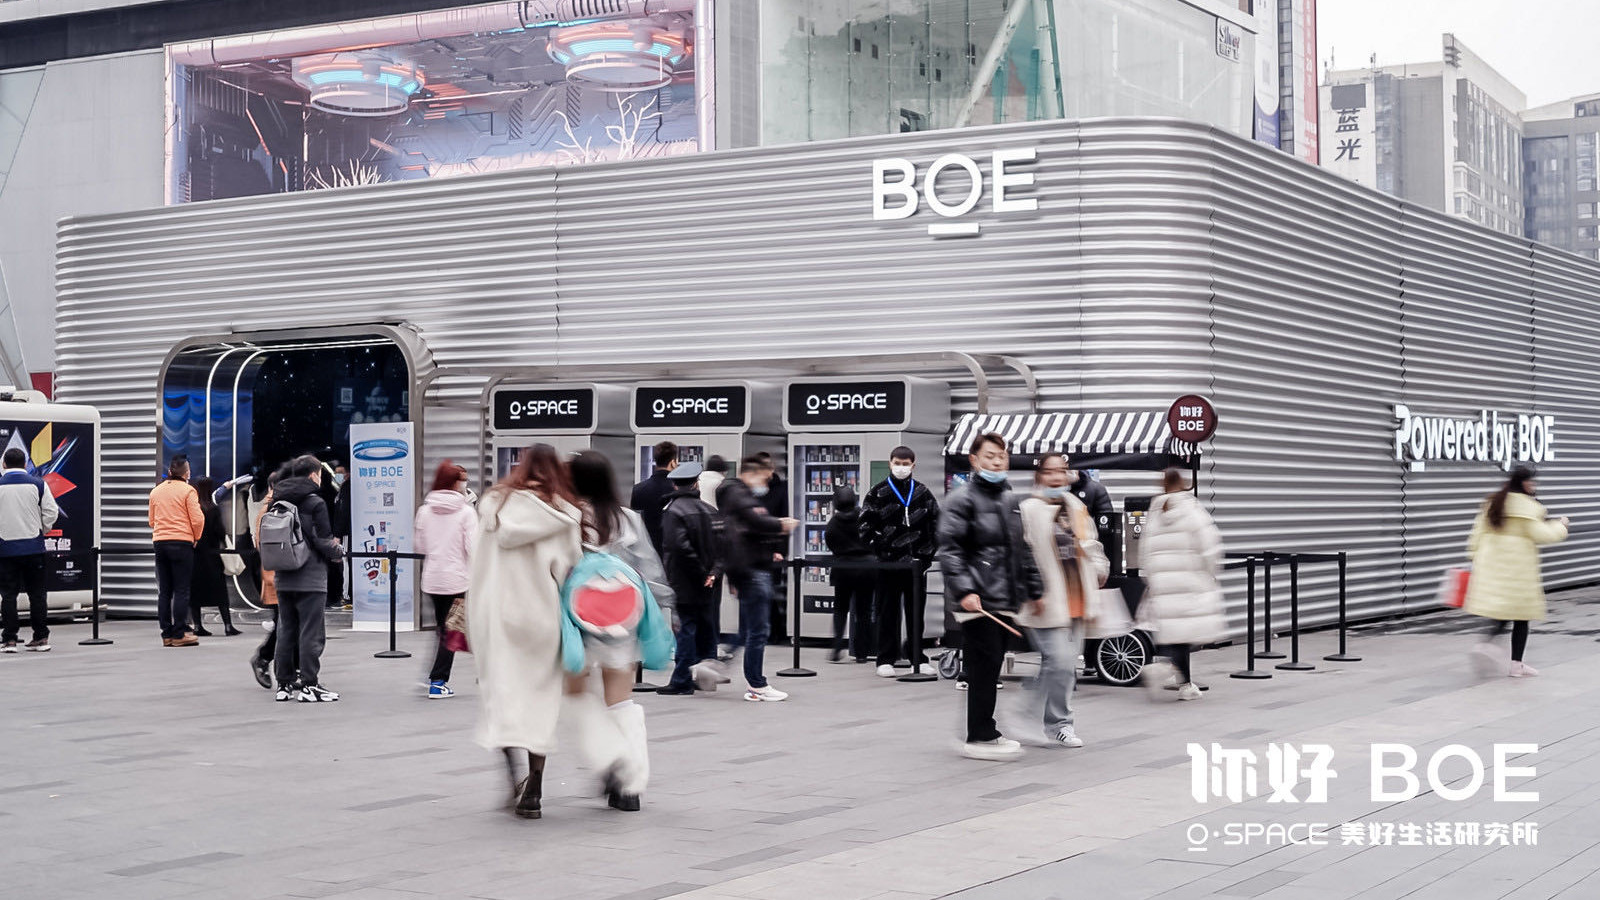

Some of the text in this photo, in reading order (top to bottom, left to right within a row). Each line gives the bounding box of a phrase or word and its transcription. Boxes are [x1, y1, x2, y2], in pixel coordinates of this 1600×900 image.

[1334, 108, 1361, 161] 蓝光
[873, 148, 1039, 235] BOE
[1178, 420, 1204, 431] BOE
[1180, 406, 1203, 417] 你好
[1395, 404, 1555, 472] Powered by BOE
[381, 466, 403, 477] BOE
